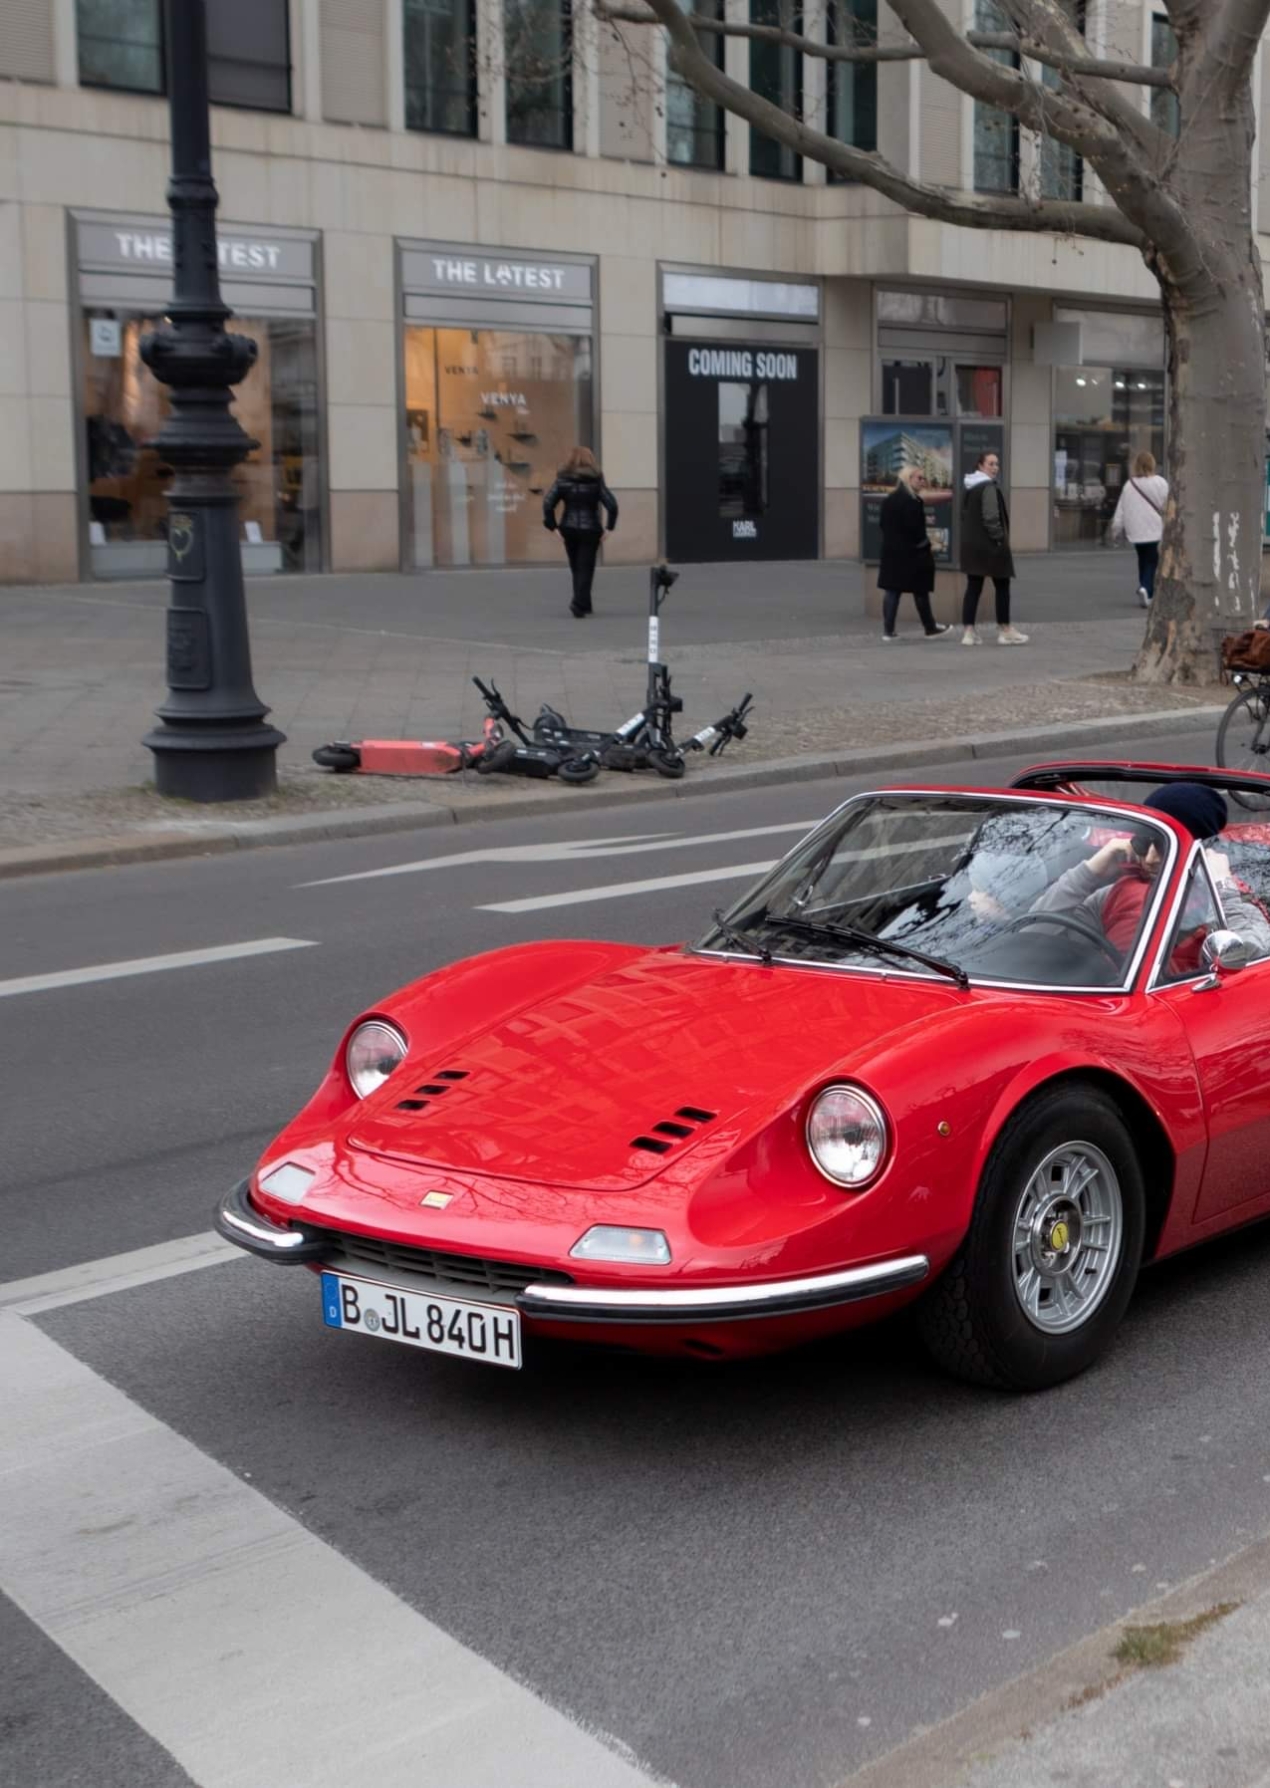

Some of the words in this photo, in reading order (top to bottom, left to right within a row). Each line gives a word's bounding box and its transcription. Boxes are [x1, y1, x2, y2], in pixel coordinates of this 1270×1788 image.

[115, 232, 172, 260] THE
[216, 241, 280, 269] TEST
[432, 259, 477, 283] THE
[484, 263, 565, 289] LATEST
[688, 348, 753, 377] COMING
[756, 352, 798, 379] SOON
[480, 391, 527, 406] VENYA
[341, 1284, 361, 1325] B
[382, 1294, 420, 1339] JL
[427, 1304, 515, 1360] 840H
